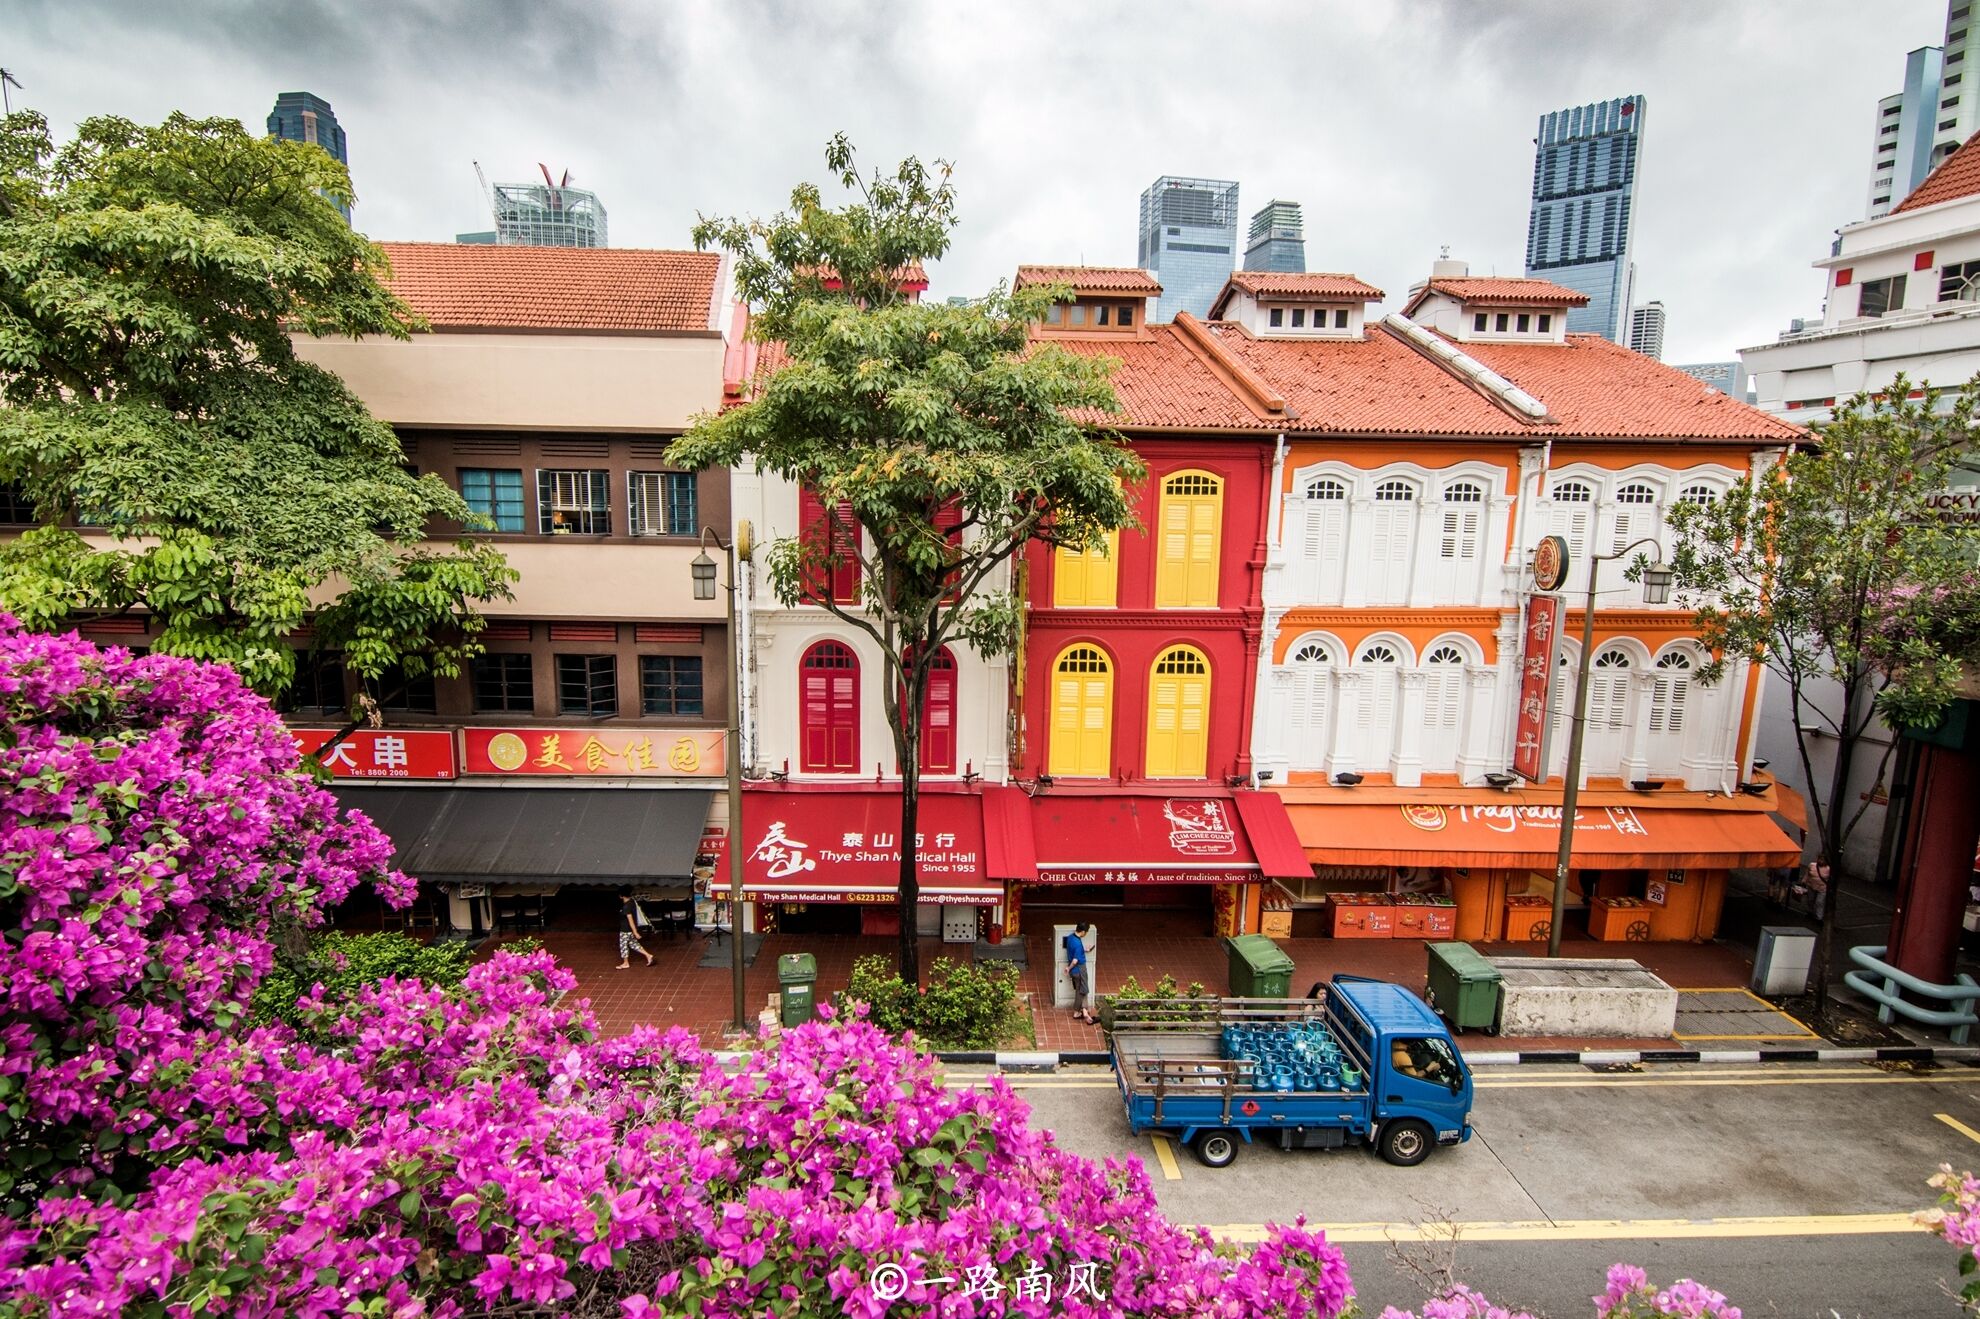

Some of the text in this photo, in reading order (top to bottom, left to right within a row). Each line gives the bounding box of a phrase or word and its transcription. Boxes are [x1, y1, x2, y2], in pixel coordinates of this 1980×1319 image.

[1922, 495, 1980, 509] UCKY
[293, 735, 408, 769] 大串
[389, 769, 409, 777] 2000
[819, 850, 976, 864] Thye Shan Mdical Hall
[922, 863, 976, 873] Since 1955
[1147, 872, 1155, 881] A
[1156, 873, 1175, 881] taste
[1176, 872, 1185, 881] of
[1186, 872, 1222, 881] tradition.
[1224, 872, 1246, 881] Since
[763, 893, 779, 901] Thye
[799, 893, 826, 901] Medical
[827, 893, 841, 901] Hall
[876, 894, 895, 902] 1326
[1651, 892, 1662, 900] 20
